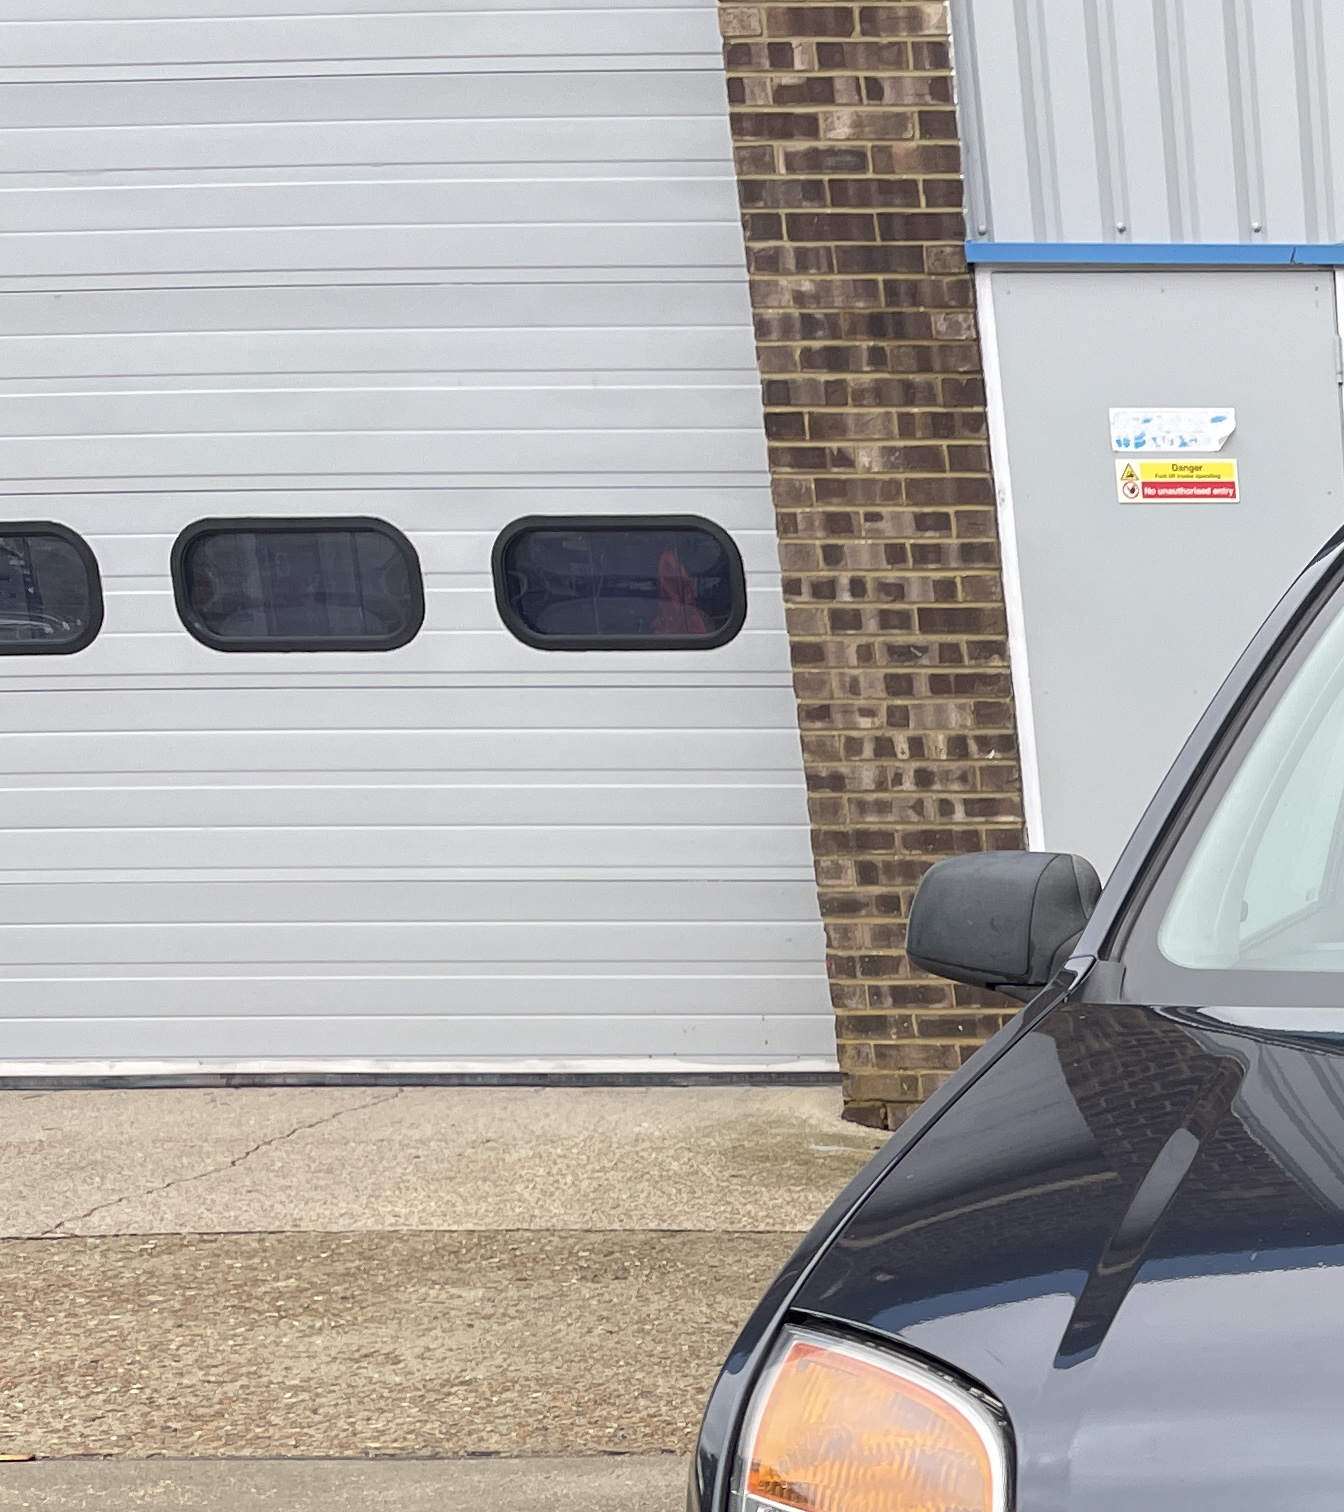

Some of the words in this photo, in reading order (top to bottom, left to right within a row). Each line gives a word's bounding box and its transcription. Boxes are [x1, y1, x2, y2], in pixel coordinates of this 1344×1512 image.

[1171, 463, 1203, 473] Danger
[1144, 486, 1157, 496] No
[1157, 486, 1212, 496] unauthorised
[1212, 487, 1234, 497] entry
